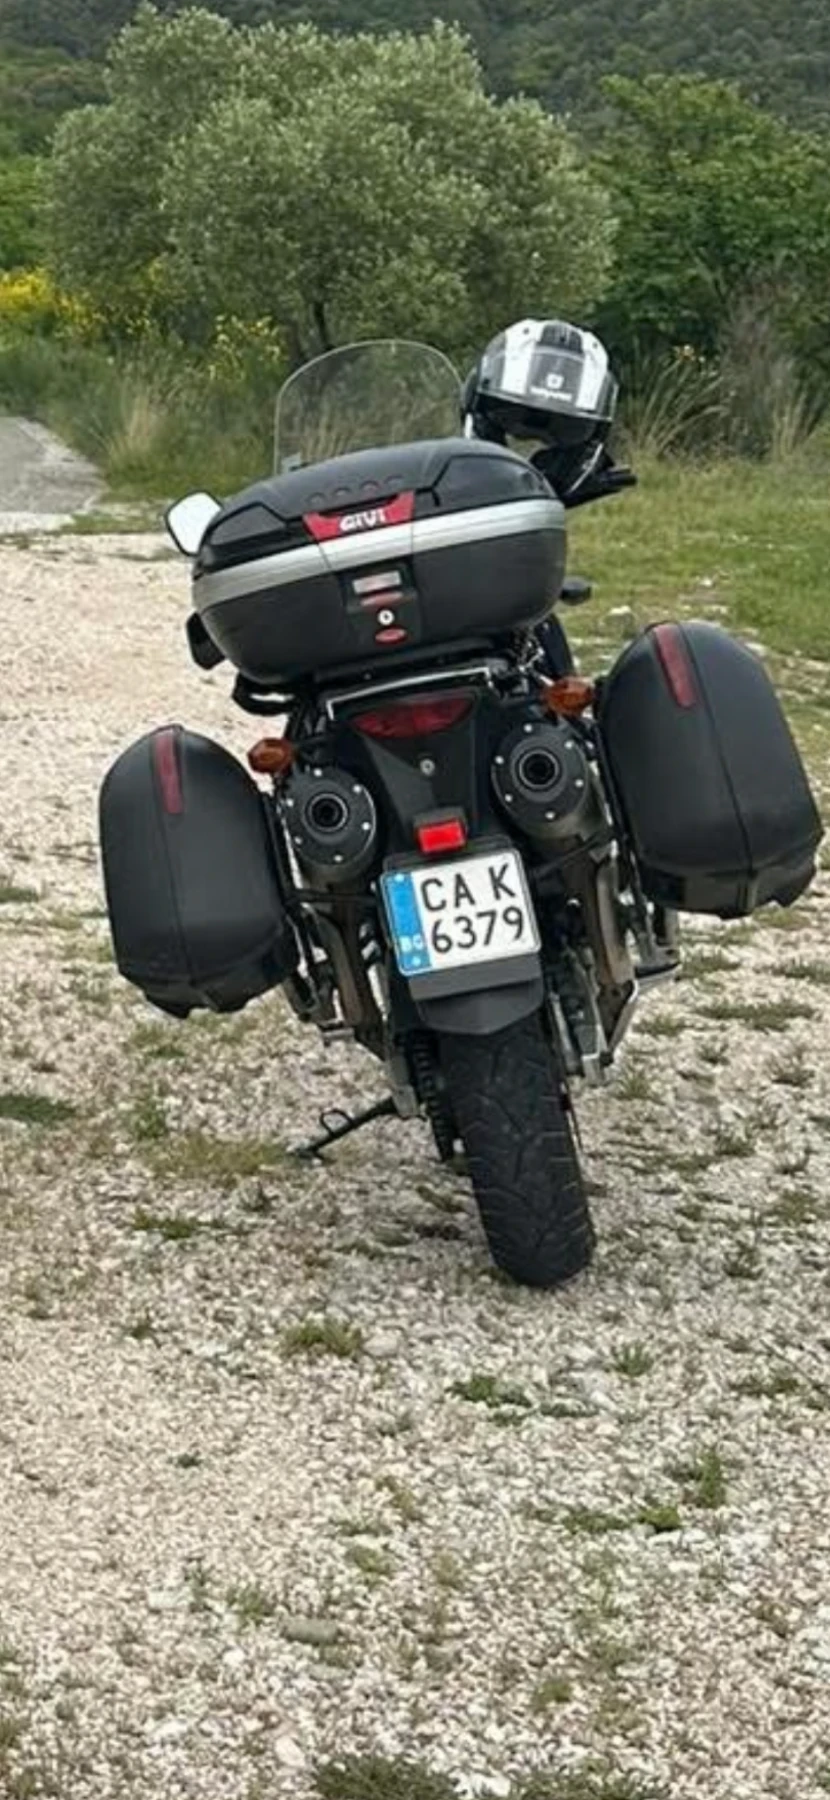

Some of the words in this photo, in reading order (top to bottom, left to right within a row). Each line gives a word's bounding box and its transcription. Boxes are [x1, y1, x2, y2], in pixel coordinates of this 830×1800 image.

[339, 508, 386, 531] GIVI
[421, 873, 475, 912] CA
[488, 863, 516, 900] K
[431, 906, 524, 953] 6379
